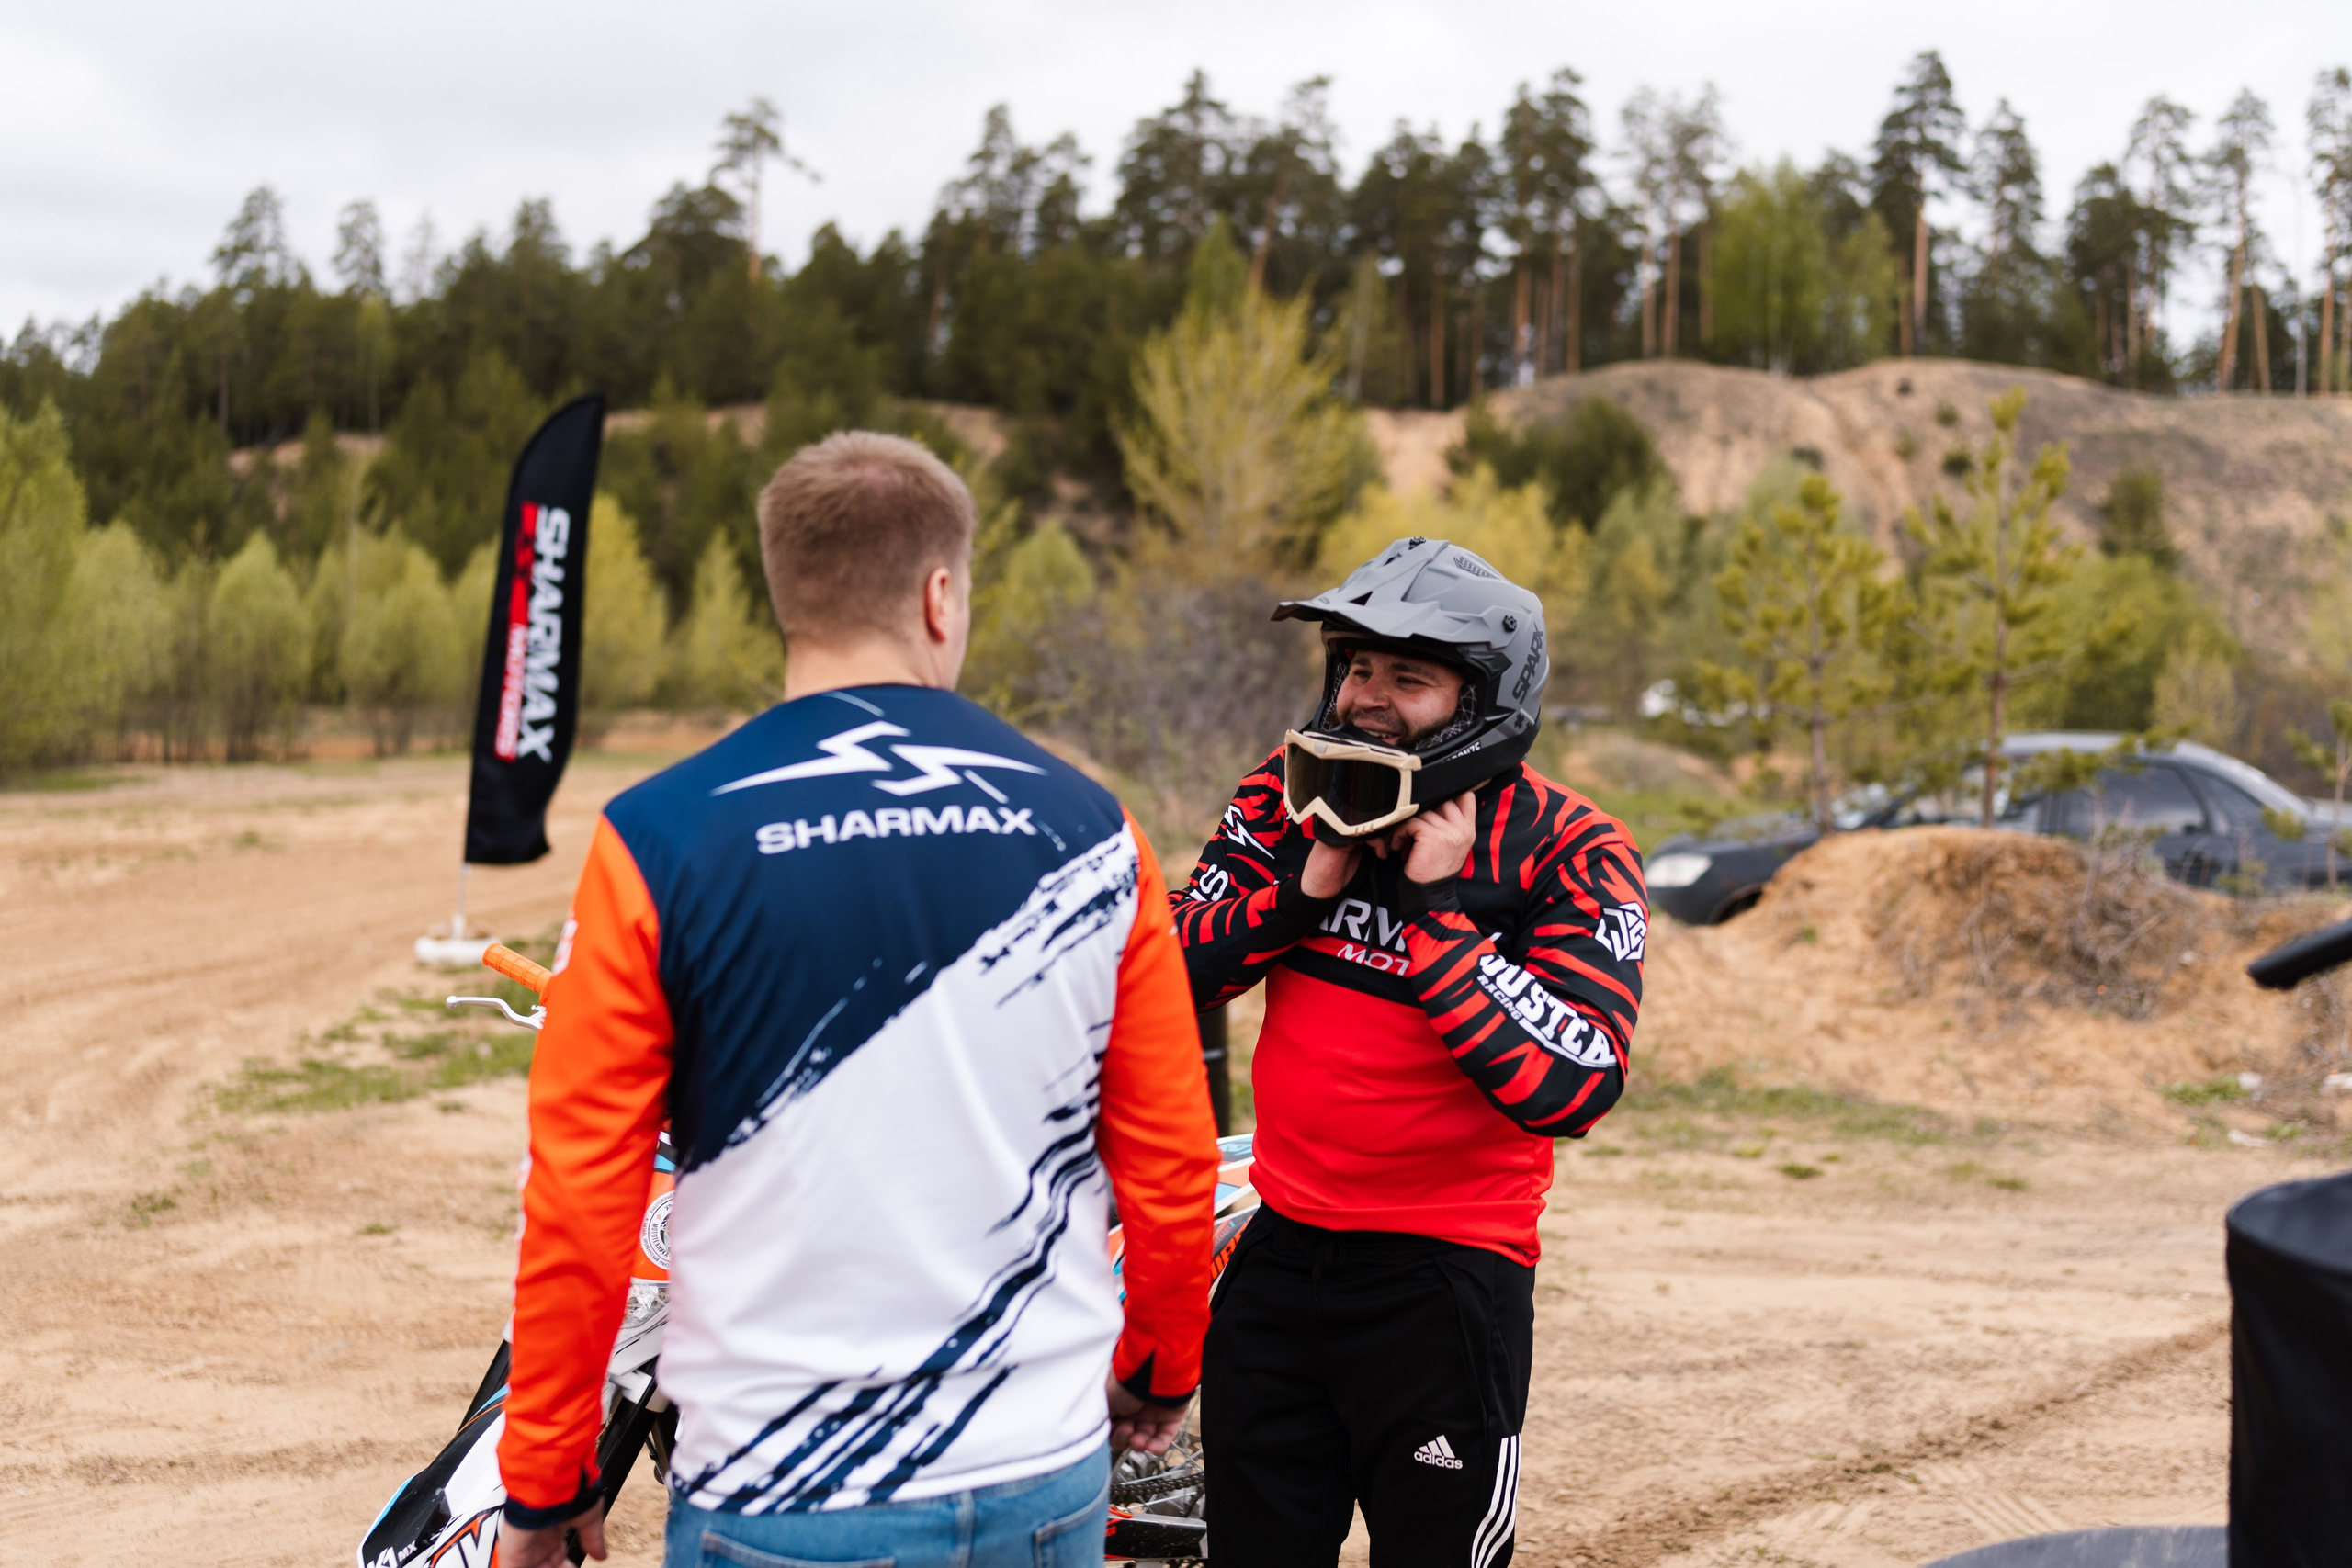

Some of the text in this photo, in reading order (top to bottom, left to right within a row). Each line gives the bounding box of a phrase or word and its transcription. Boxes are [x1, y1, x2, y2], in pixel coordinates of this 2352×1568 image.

[516, 505, 570, 763] SHARMAX
[756, 805, 1037, 854] SHARMAX
[1476, 974, 1523, 1021] RACING
[651, 1223, 670, 1258] МОТОТЕХНИКА
[1414, 1451, 1463, 1470] adidas
[398, 1540, 417, 1562] MX
